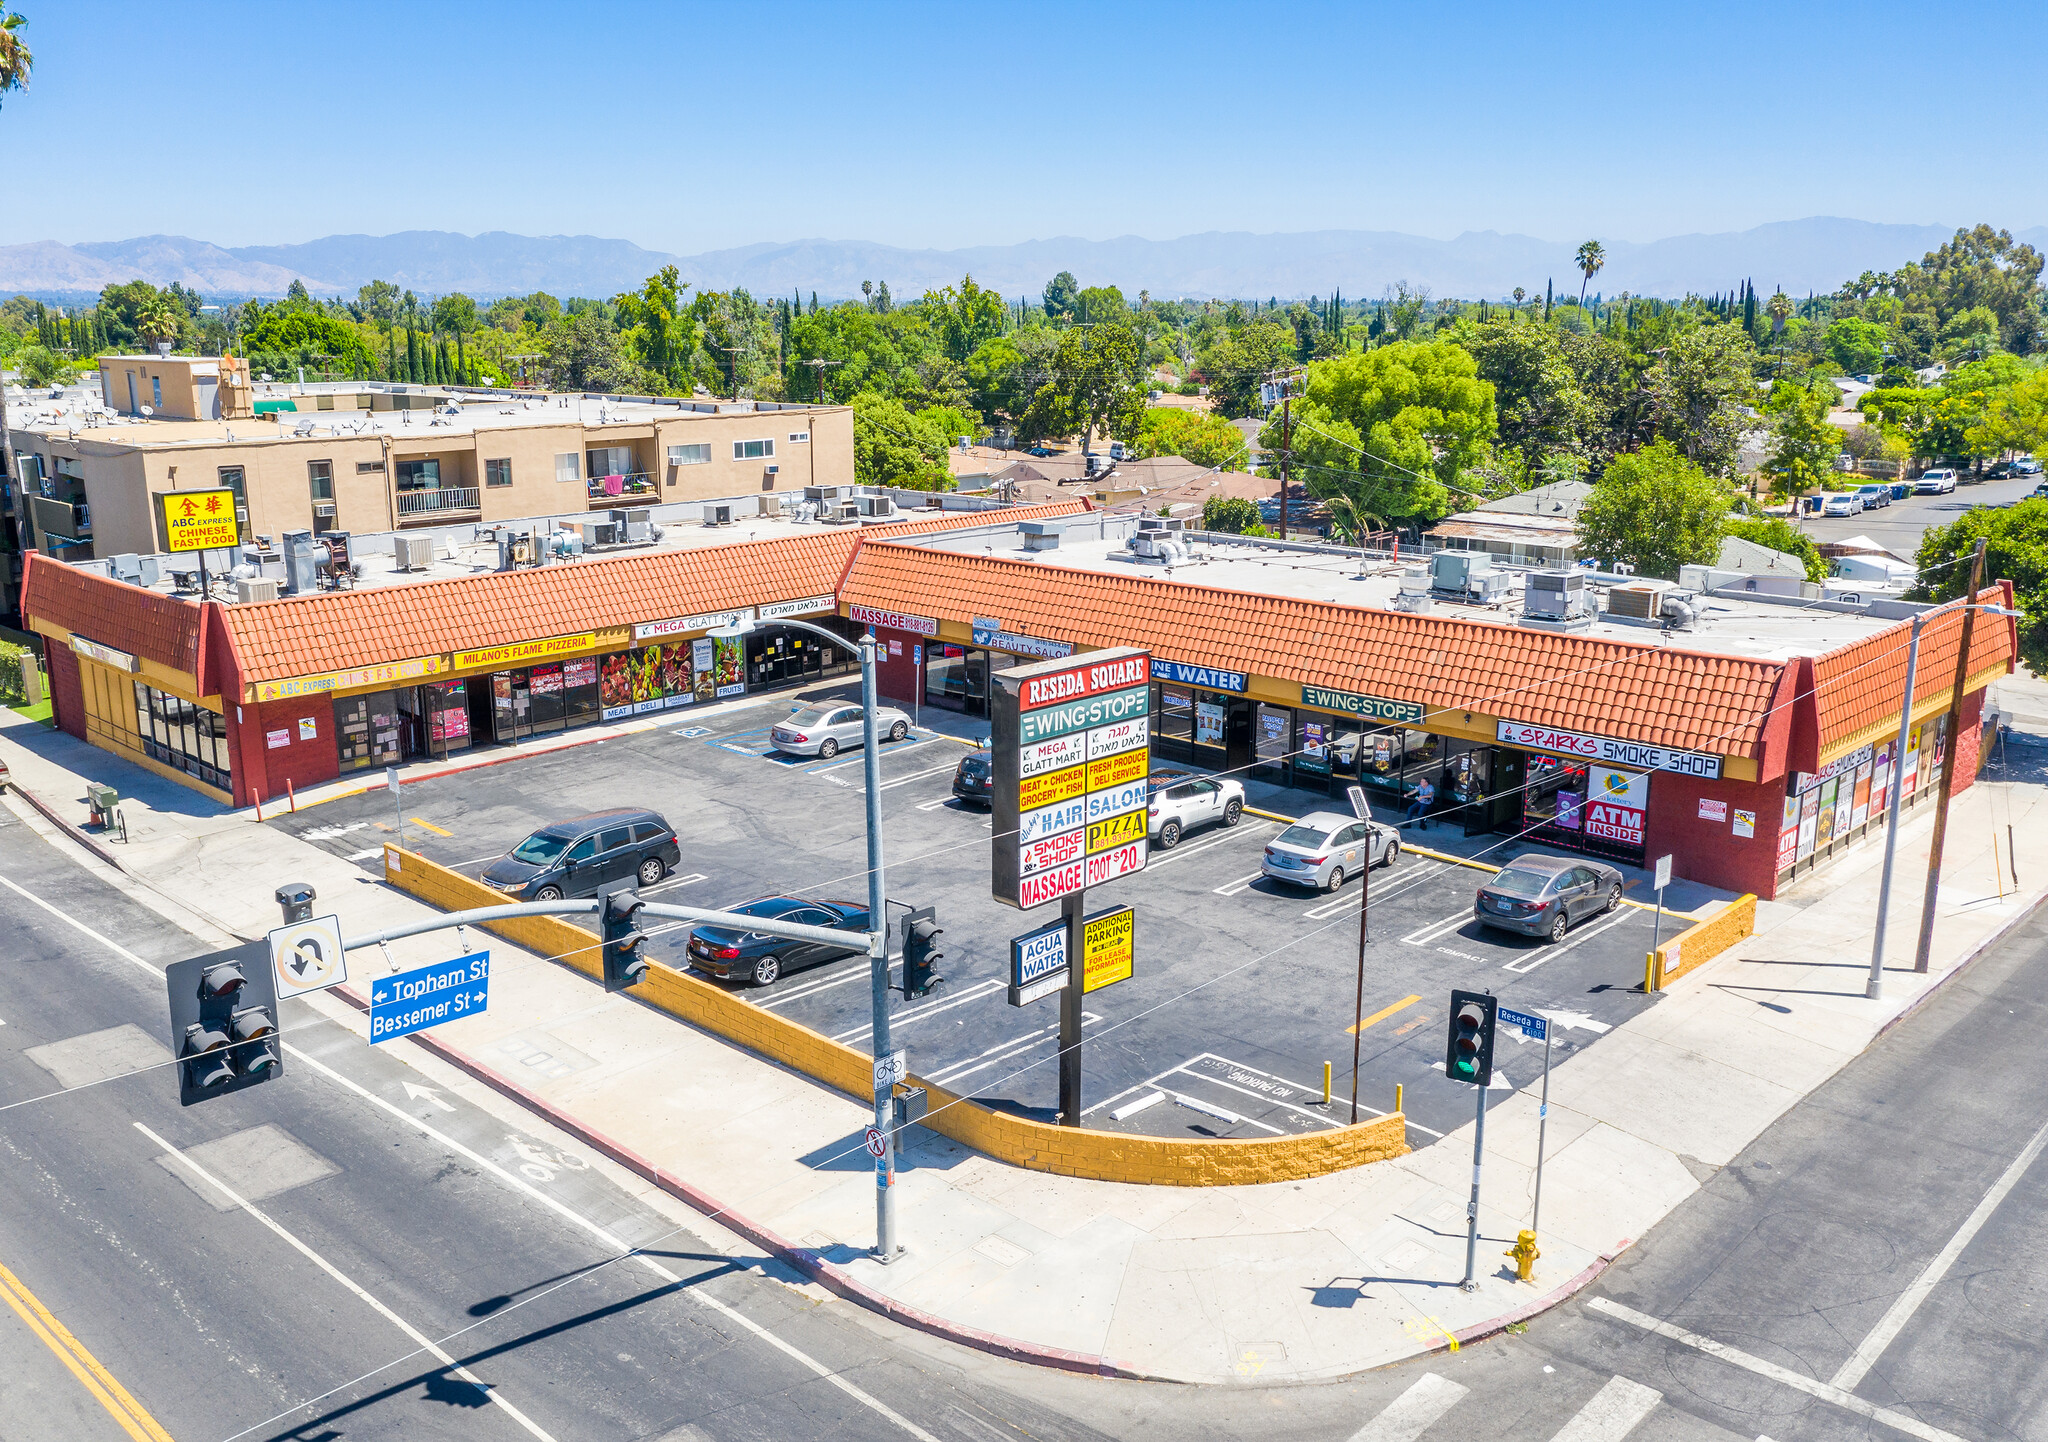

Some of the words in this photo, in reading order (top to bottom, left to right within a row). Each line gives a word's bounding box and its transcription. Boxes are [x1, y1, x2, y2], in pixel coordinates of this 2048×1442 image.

[172, 518, 195, 528] ABC
[197, 517, 233, 526] EXPRESS
[178, 526, 228, 538] CHINESE
[174, 538, 201, 548] FAST
[205, 535, 235, 545] FOOD
[654, 620, 685, 634] MEGA
[688, 614, 718, 628] GLATT
[852, 608, 904, 628] MASSAGE
[464, 649, 510, 664] MILANO'S
[512, 644, 543, 656] FLAME
[546, 637, 587, 651] PIZZERIA
[992, 639, 1032, 654] BEAUTY
[1035, 646, 1071, 658] SALON
[564, 664, 582, 672] ONE
[1176, 664, 1241, 690] WATER
[280, 681, 300, 696] ABC
[303, 678, 336, 692] EXPRESS
[338, 670, 374, 686] CHINESE
[377, 666, 398, 680] FAST
[400, 662, 424, 677] FOOD
[719, 685, 742, 694] FRUITS
[1029, 672, 1085, 704] RESEDA
[1090, 659, 1144, 690] SQUARE
[608, 708, 627, 717] MEAT
[640, 702, 656, 710] DELI
[1108, 725, 1130, 739] מגה
[1121, 733, 1145, 748] גלאט
[1038, 742, 1066, 757] MEGA
[1092, 740, 1118, 756] מארט
[1519, 728, 1598, 754] SPARKS
[1603, 742, 1661, 766] SMOKE
[1668, 753, 1716, 775] SHOP
[1022, 758, 1053, 774] GLATT
[1056, 750, 1081, 765] MART
[1090, 762, 1112, 775] FRESH
[1114, 752, 1146, 768] PRODUCE
[1536, 756, 1556, 766] OPEN
[1020, 780, 1041, 794] MEAT
[1050, 768, 1083, 786] CHICKEN
[1095, 774, 1110, 786] DELI
[1112, 765, 1140, 781] SERVICE
[1021, 788, 1057, 806] GROCERY
[1066, 782, 1083, 794] FISH
[1090, 786, 1146, 816] SALON
[1042, 805, 1082, 833] HAIR
[1590, 805, 1641, 829] ATM
[1090, 813, 1144, 849] PIZZA
[1095, 830, 1132, 849] 881-9373
[1590, 823, 1638, 842] INSIDE
[1780, 830, 1797, 853] ATM
[1034, 831, 1083, 856] SMOKE
[1040, 846, 1078, 868] SHOP
[1089, 854, 1111, 884] FOOT
[1022, 864, 1081, 907] MASSAGE
[1087, 913, 1131, 934] ADDITIONAL
[1087, 922, 1130, 946] PARKING
[1026, 933, 1062, 960] AGUA
[1089, 956, 1102, 965] FOR
[1105, 948, 1126, 960] LEASE
[1436, 946, 1488, 963] COMPACT
[1024, 950, 1064, 978] WATER
[1084, 954, 1130, 975] INFORMATION
[393, 969, 465, 1000] Topham
[470, 959, 487, 979] St
[373, 1001, 451, 1036] Bessemer
[454, 992, 470, 1012] St
[1501, 1010, 1531, 1026] Reseda
[1526, 1028, 1542, 1038] 6100
[1227, 1072, 1276, 1091] PARKING
[1272, 1087, 1294, 1097] NO
